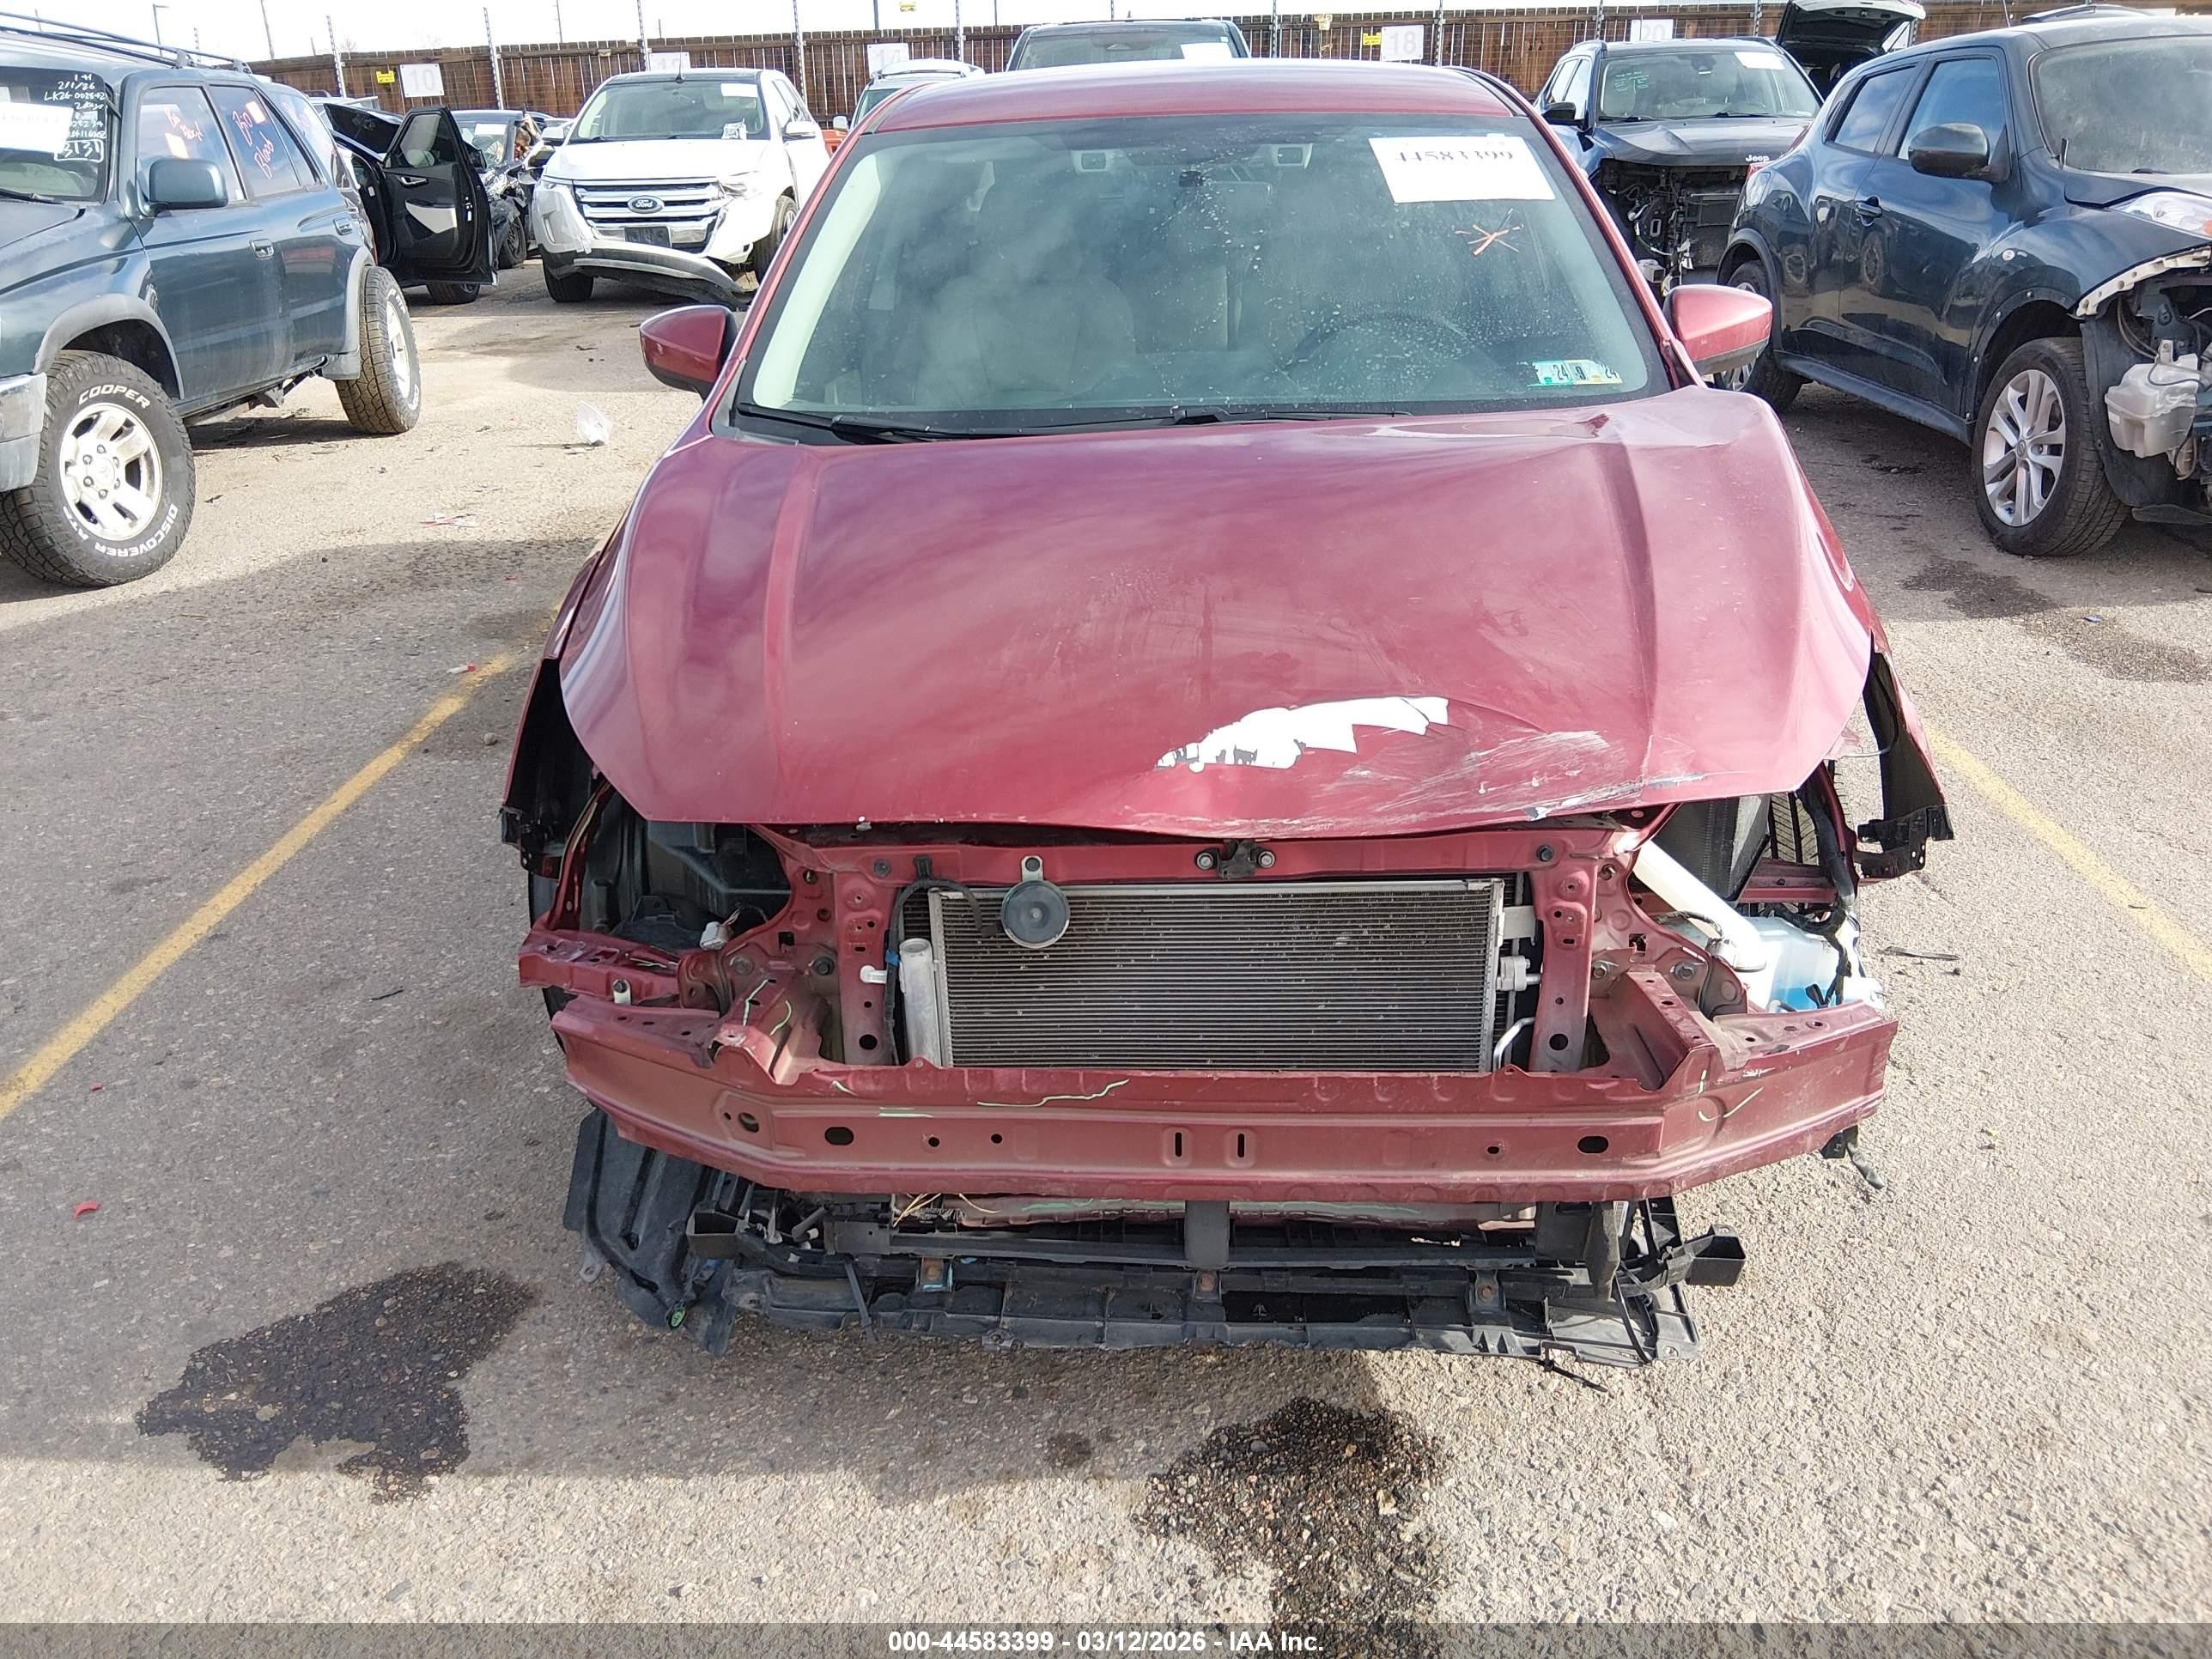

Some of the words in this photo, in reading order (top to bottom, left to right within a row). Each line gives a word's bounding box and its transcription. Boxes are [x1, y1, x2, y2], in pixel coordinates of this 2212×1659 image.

[1390, 30, 1417, 54] 18
[410, 69, 434, 91] 10
[635, 199, 653, 208] Ford
[78, 384, 150, 409] COOPER
[95, 503, 179, 557] DISCOVERER
